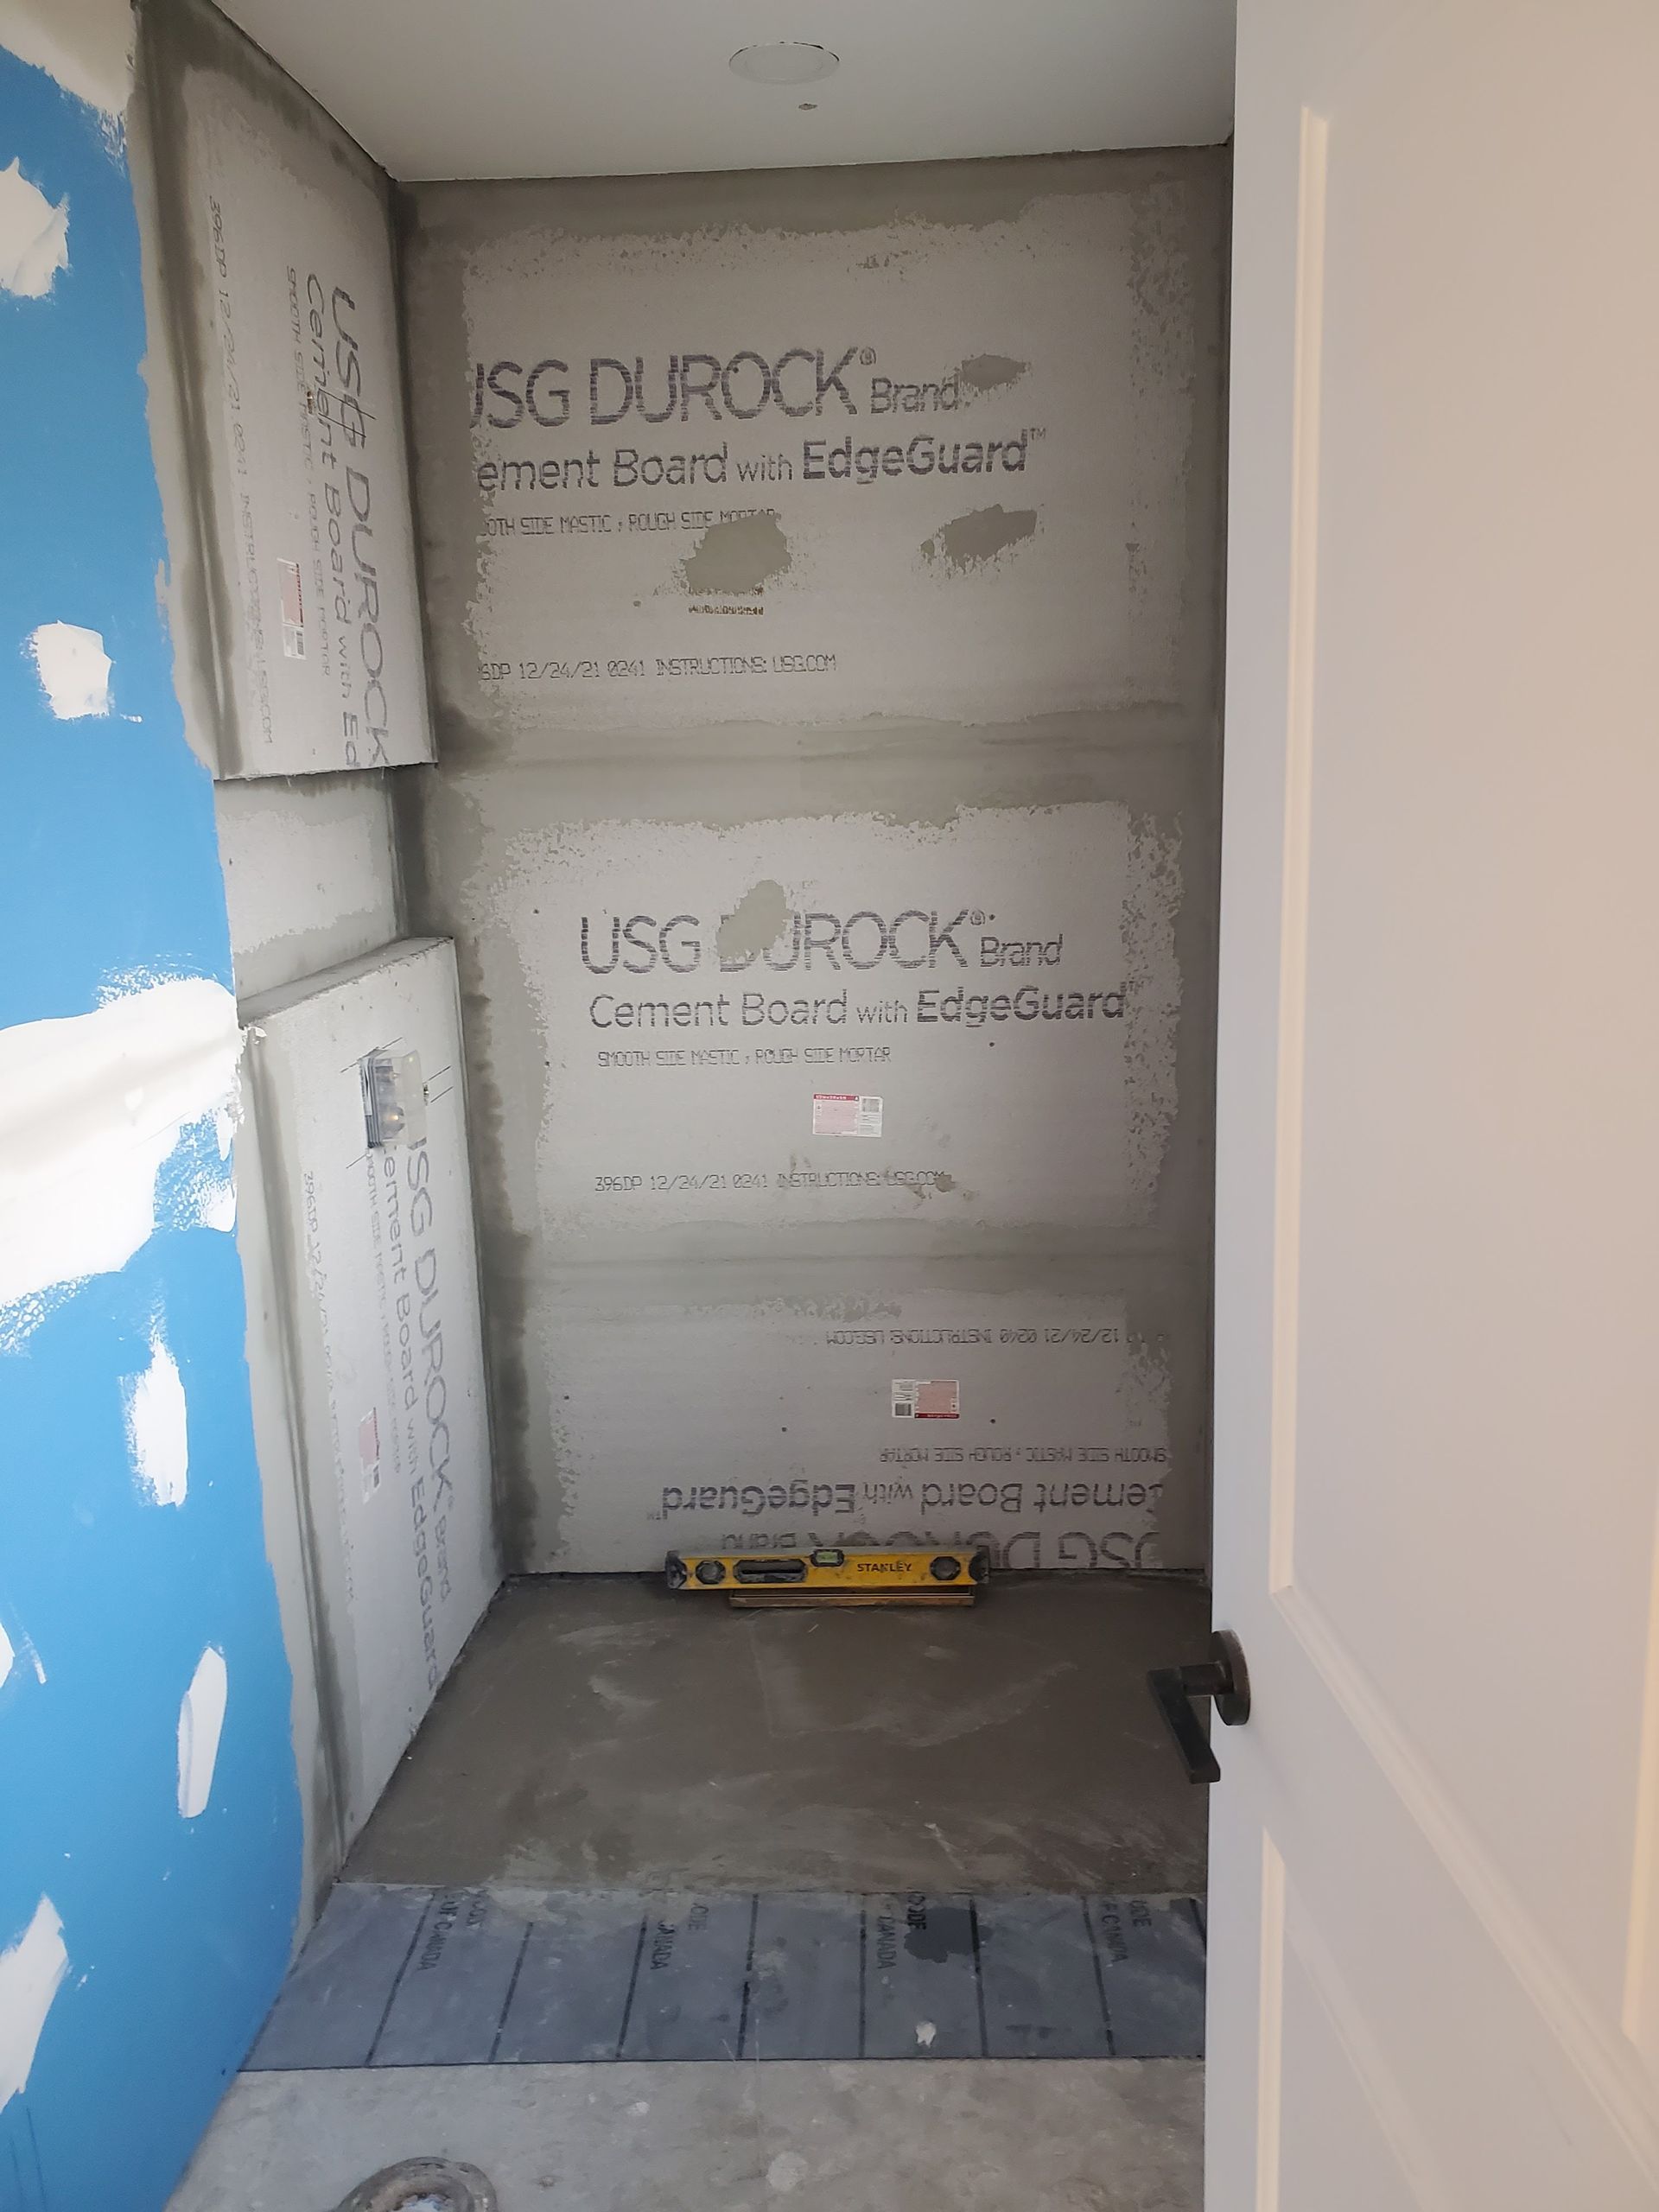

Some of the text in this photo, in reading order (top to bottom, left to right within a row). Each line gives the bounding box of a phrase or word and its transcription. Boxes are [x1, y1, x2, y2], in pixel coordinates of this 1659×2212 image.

[208, 195, 226, 278] 396DP
[286, 265, 301, 343] SMOOTH
[293, 351, 305, 395] SIDE
[871, 373, 958, 414] Brand
[477, 448, 600, 491] ement
[613, 442, 728, 486] Board
[737, 454, 793, 482] with
[520, 516, 554, 535] SIDE
[560, 514, 612, 533] MASTIC
[628, 512, 676, 532] ROUGH
[313, 560, 324, 600] SIDE
[324, 483, 350, 624] Board
[337, 637, 352, 698] with
[519, 660, 600, 680] 12/24/21
[607, 659, 645, 677] 0241
[581, 915, 701, 974] USG
[980, 933, 1064, 967] Brand
[590, 994, 730, 1028] Cement
[742, 988, 847, 1026] Board
[856, 1000, 908, 1024] with
[598, 1051, 650, 1068] SMOOTH
[656, 1050, 685, 1065] SIDE
[691, 1049, 740, 1065] MASTIC
[755, 1047, 798, 1064] ROUGH
[804, 1047, 834, 1064] SIDE
[839, 1046, 891, 1063] MORTAR
[594, 1176, 642, 1192] 396DP
[651, 1175, 725, 1190] 12/24/21
[733, 1174, 767, 1189] 0241
[1043, 1326, 1118, 1344] 12/24/21
[383, 1147, 439, 1690] ement Board with EdgeGuard
[932, 1446, 963, 1461] SIDE
[969, 1446, 1010, 1461] ROUGH
[1025, 1446, 1071, 1461] MASTIC
[1077, 1446, 1109, 1461] SIDE
[1114, 1446, 1166, 1462] SMOOTH
[862, 1483, 912, 1503] with
[920, 1483, 1022, 1514] Board
[857, 1563, 912, 1573] STANLEY
